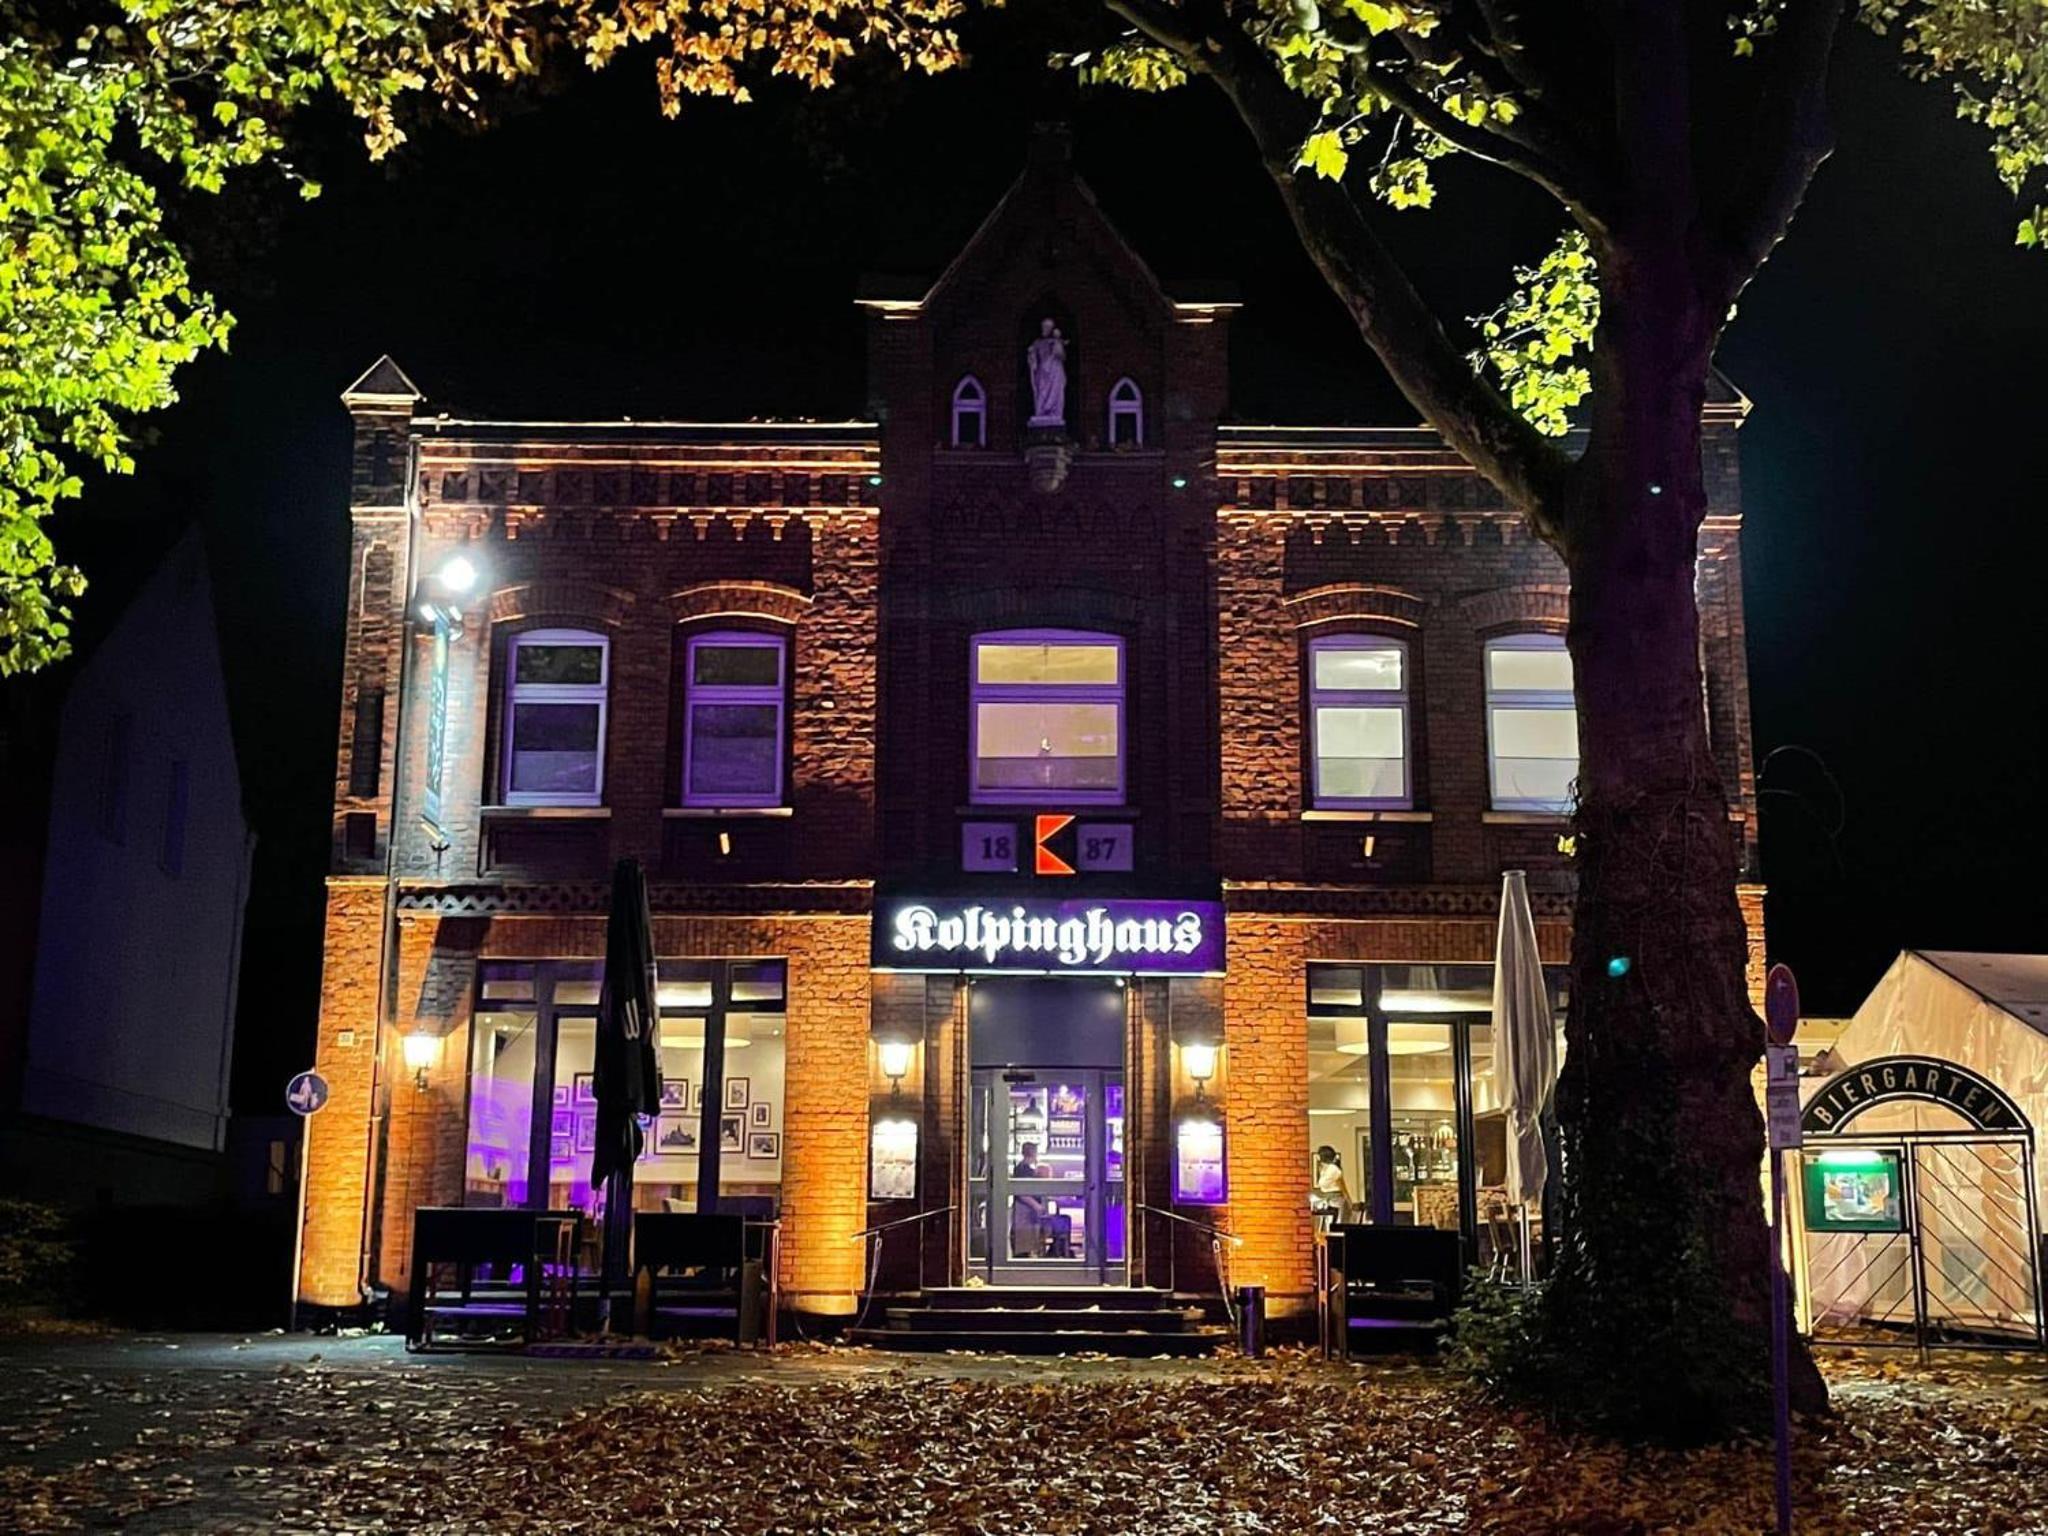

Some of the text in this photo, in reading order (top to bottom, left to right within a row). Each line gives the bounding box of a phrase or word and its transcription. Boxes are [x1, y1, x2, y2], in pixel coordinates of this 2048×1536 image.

[981, 836, 1011, 862] 18
[1085, 837, 1117, 861] 87
[893, 904, 1203, 965] Kolpinghaus
[1812, 1066, 2002, 1127] BIERGARTEN
